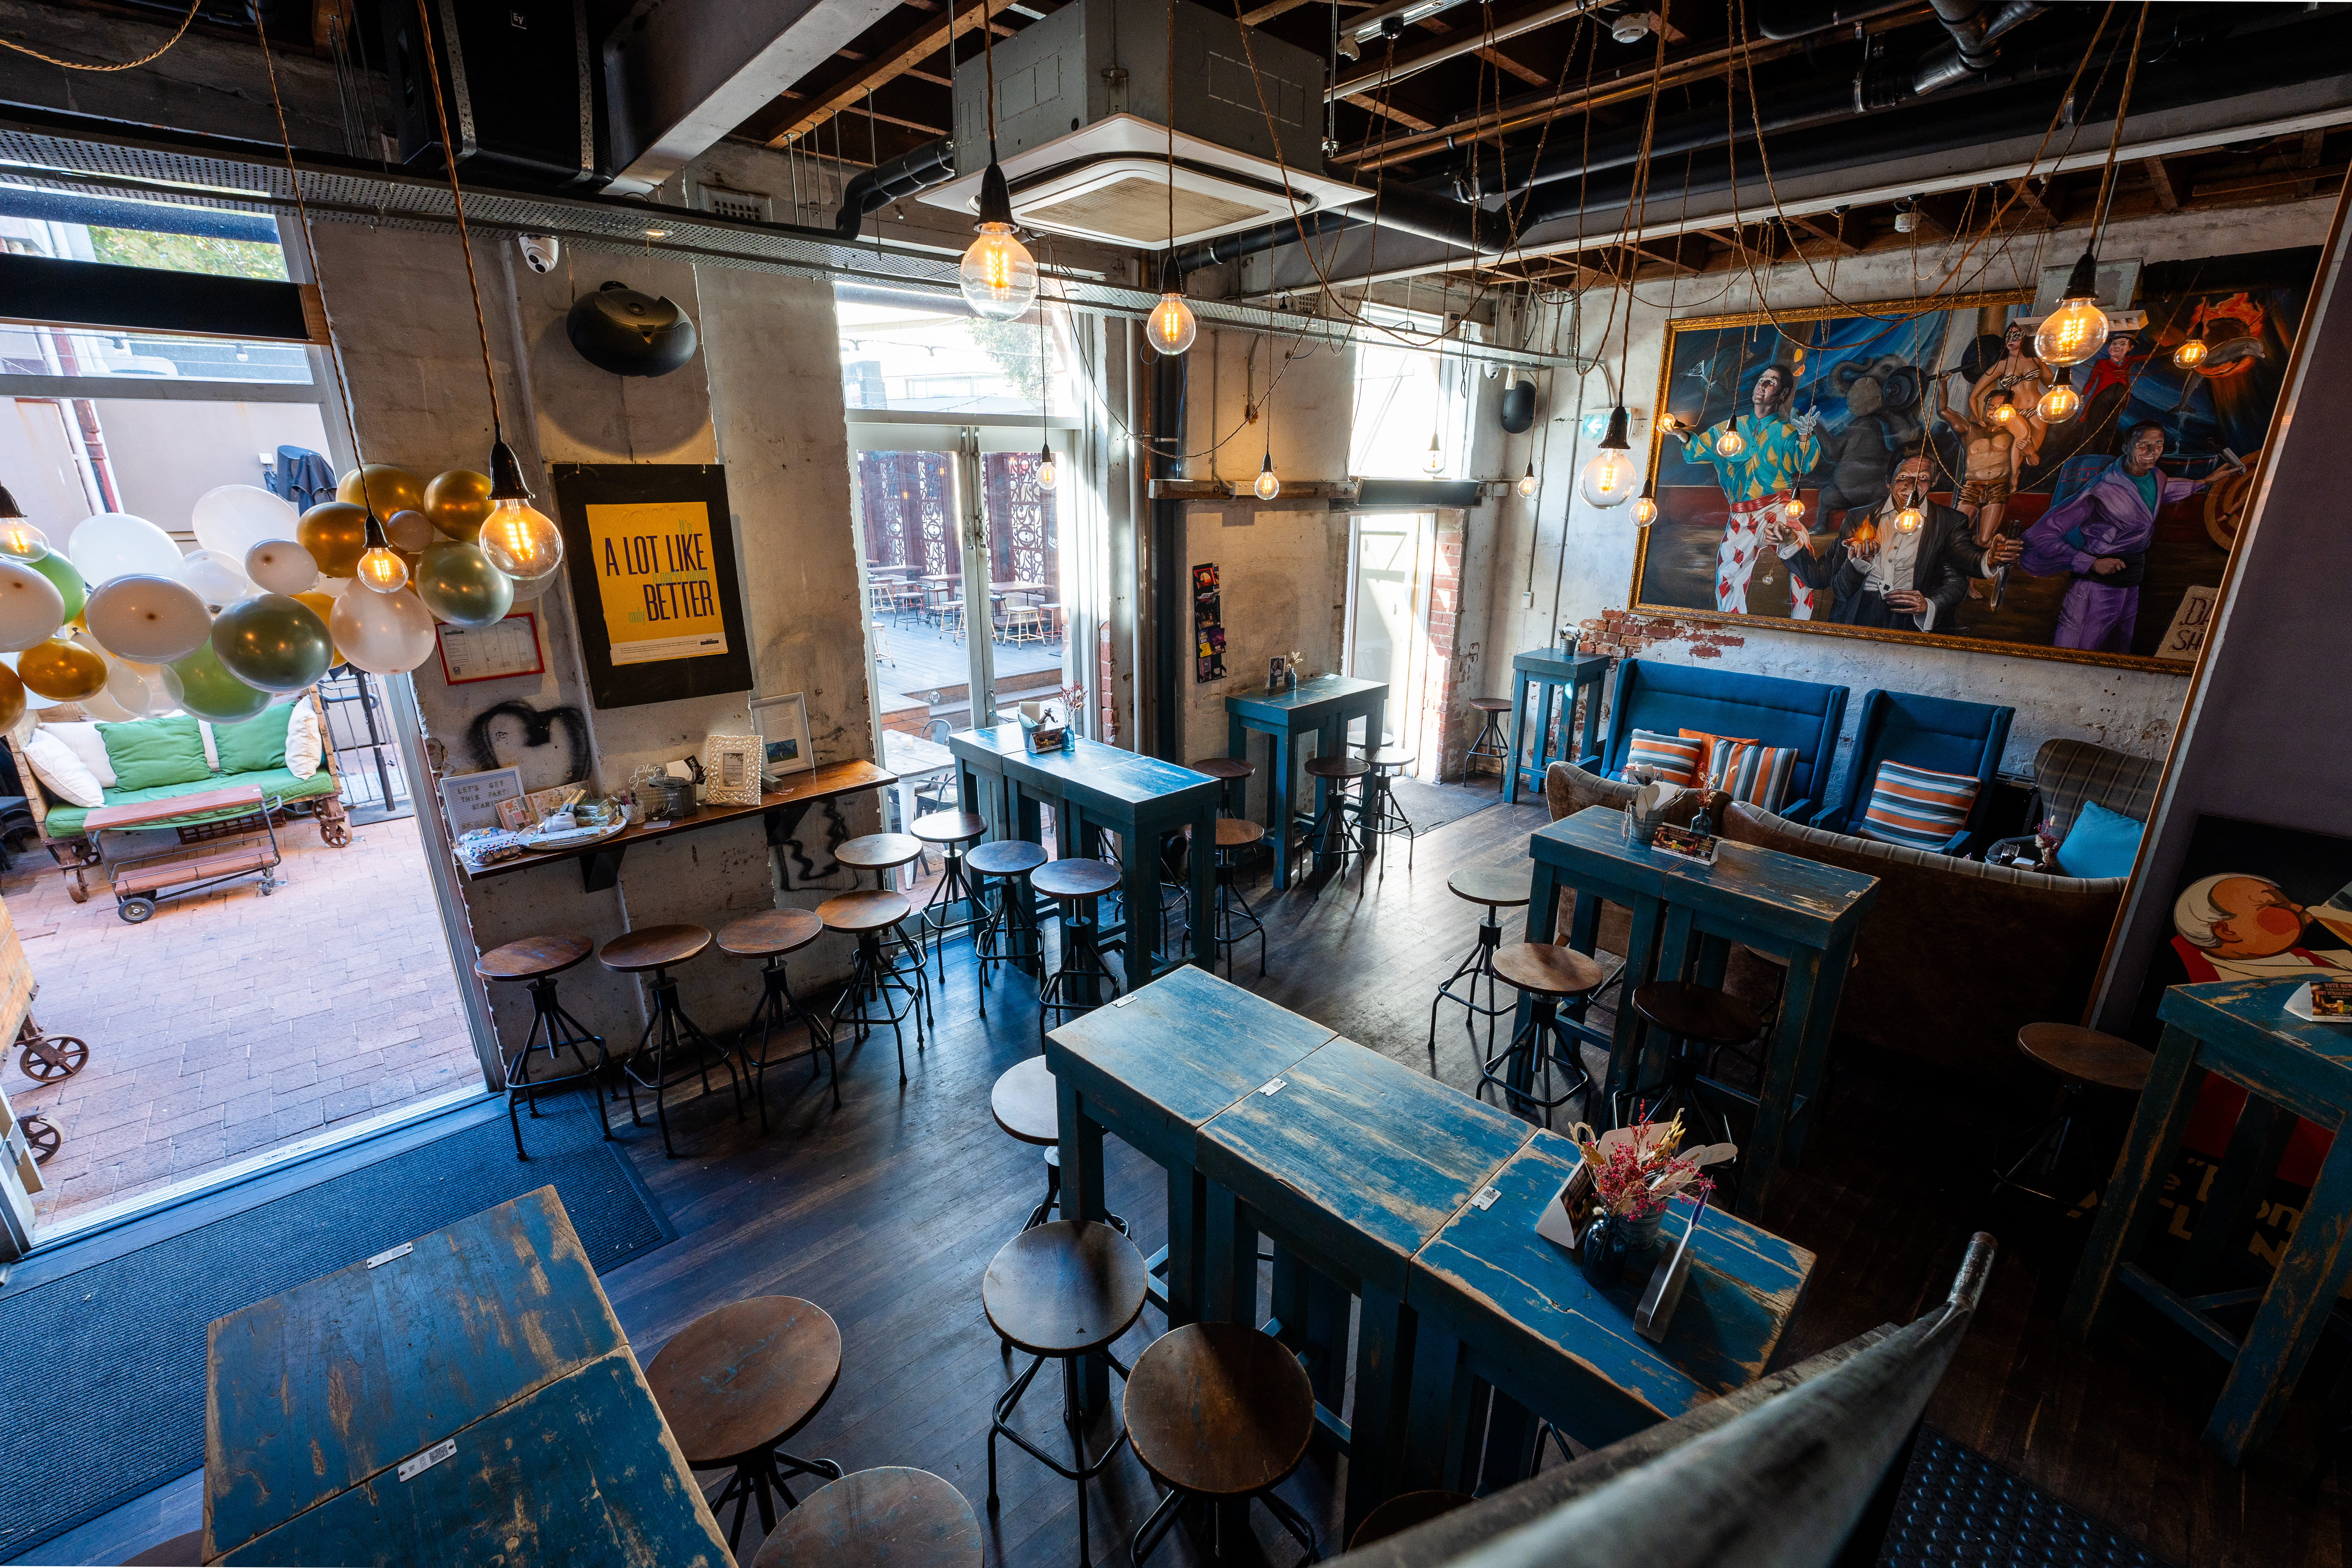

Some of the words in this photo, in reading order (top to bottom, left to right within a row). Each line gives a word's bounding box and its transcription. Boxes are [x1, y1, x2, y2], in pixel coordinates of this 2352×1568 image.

[679, 519, 692, 535] It's
[605, 537, 620, 576] A
[623, 536, 659, 575] LOT
[665, 533, 708, 572] LIKE
[652, 572, 658, 584] a
[660, 569, 683, 586] party
[685, 569, 709, 582] venue
[643, 580, 715, 621] BETTER
[628, 607, 646, 625] only
[635, 764, 662, 778] Photo
[458, 785, 479, 794] LET'S
[488, 789, 511, 797] PARTY
